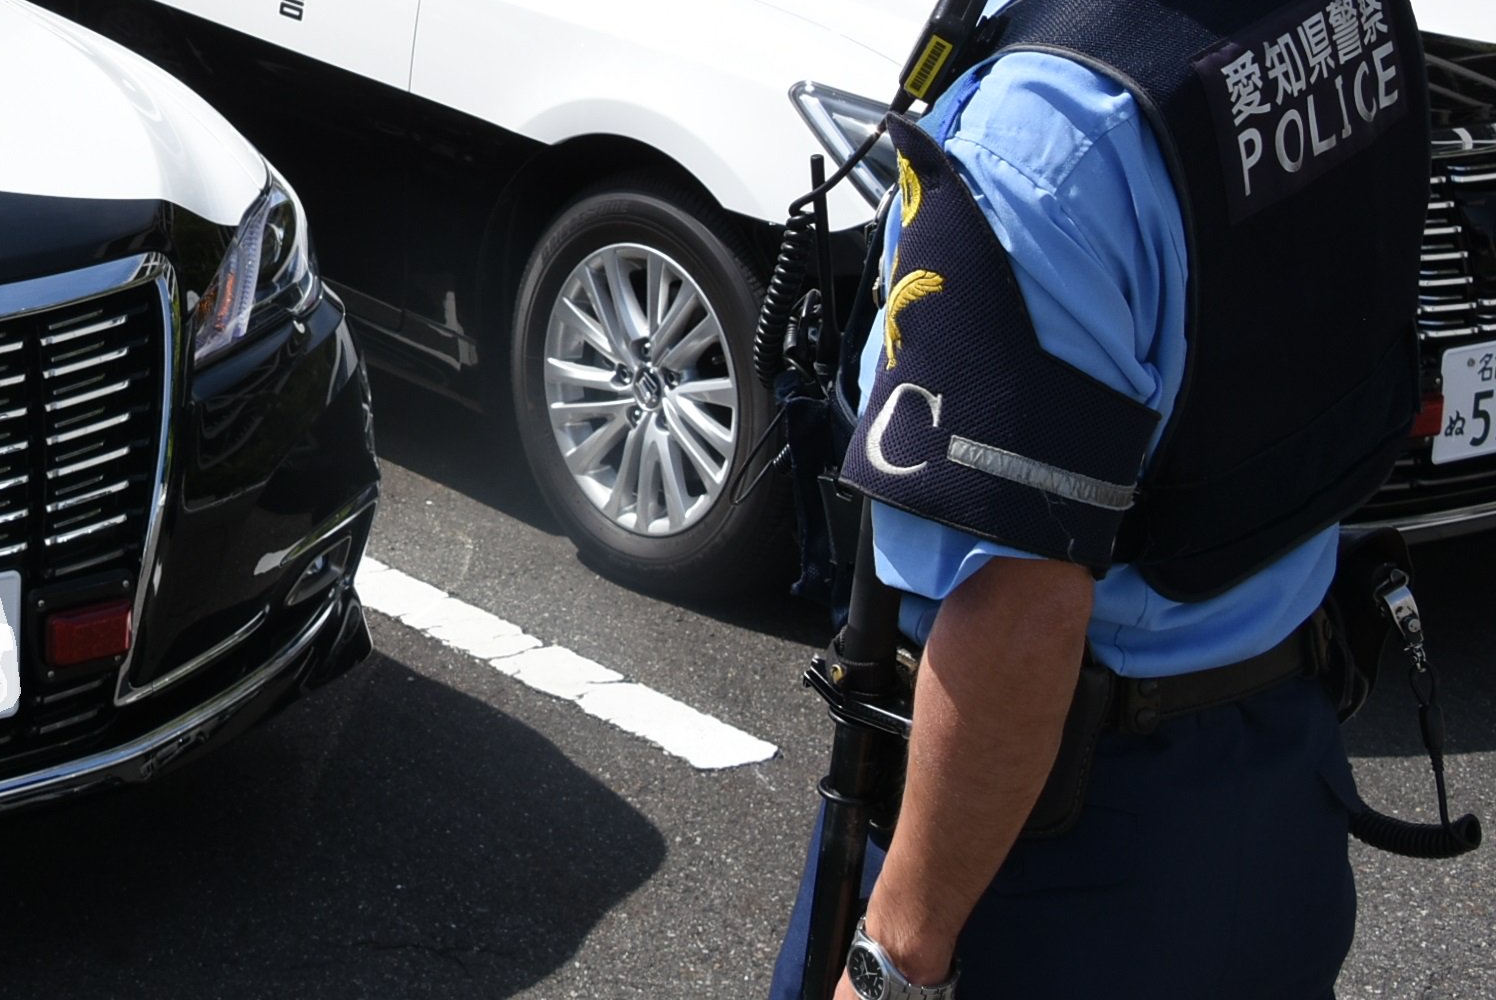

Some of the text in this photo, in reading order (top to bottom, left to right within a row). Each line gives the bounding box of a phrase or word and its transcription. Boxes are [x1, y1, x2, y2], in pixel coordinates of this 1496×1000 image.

[1237, 41, 1399, 197] POLICE
[1477, 353, 1496, 382] 名
[866, 382, 942, 475] C
[1444, 389, 1496, 447] ぬ 5
